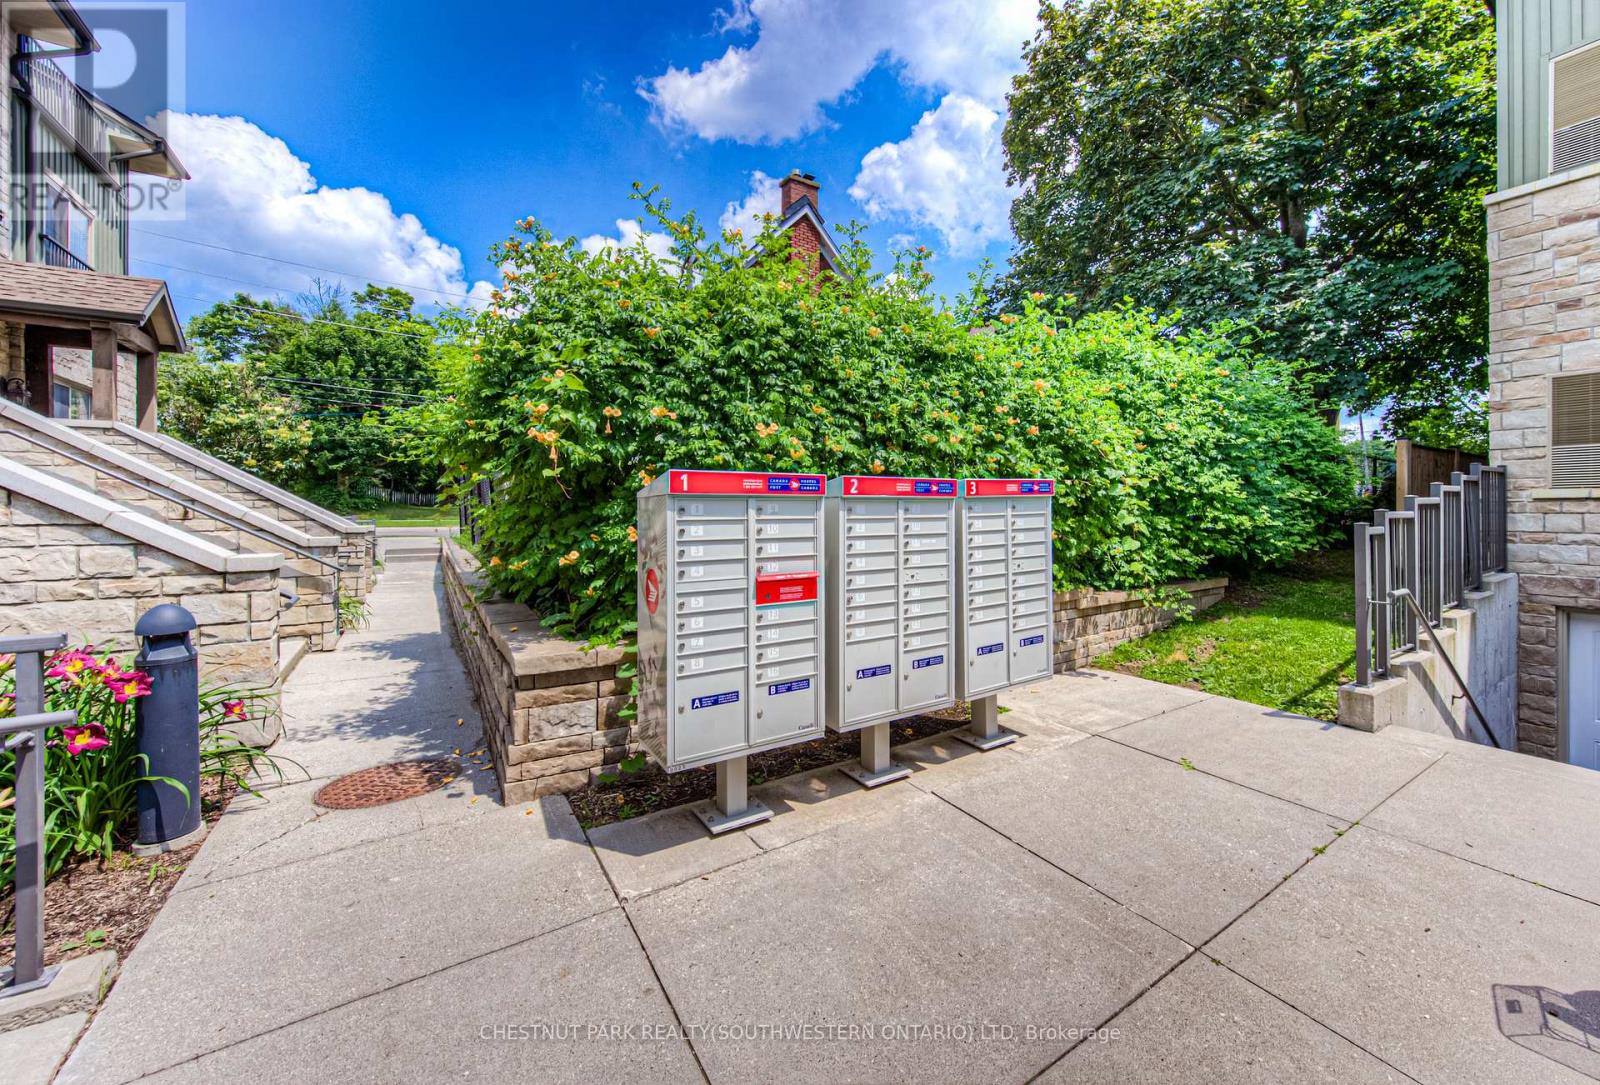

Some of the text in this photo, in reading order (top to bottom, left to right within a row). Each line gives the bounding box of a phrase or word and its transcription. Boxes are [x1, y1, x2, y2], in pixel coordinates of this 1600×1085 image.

[680, 473, 689, 491] 1
[850, 478, 859, 494] 2
[969, 481, 977, 495] 3
[977, 648, 983, 656] A
[857, 670, 864, 679] A
[770, 685, 776, 695] B
[693, 698, 701, 709] A
